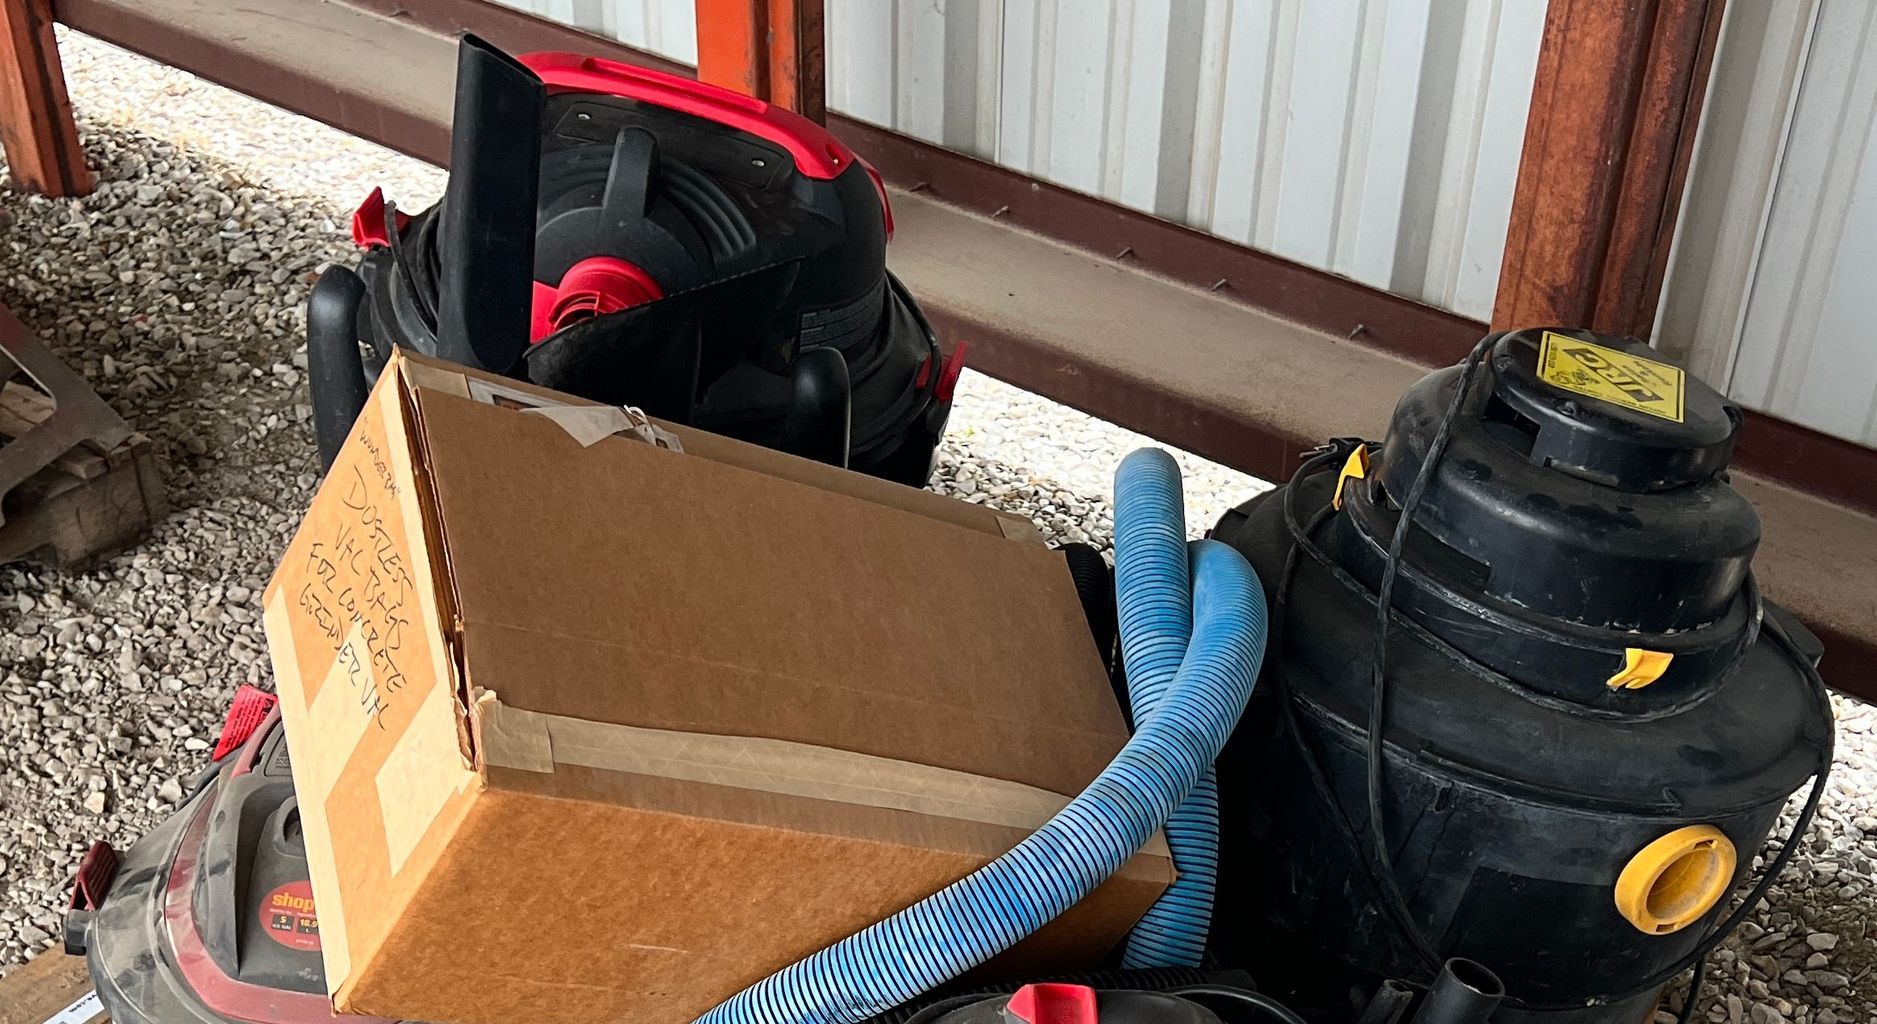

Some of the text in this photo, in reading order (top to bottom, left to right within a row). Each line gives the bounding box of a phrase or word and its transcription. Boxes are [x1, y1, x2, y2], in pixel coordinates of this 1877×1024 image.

[299, 582, 361, 687] GRINDER
[306, 542, 407, 693] FOR CONCRETE
